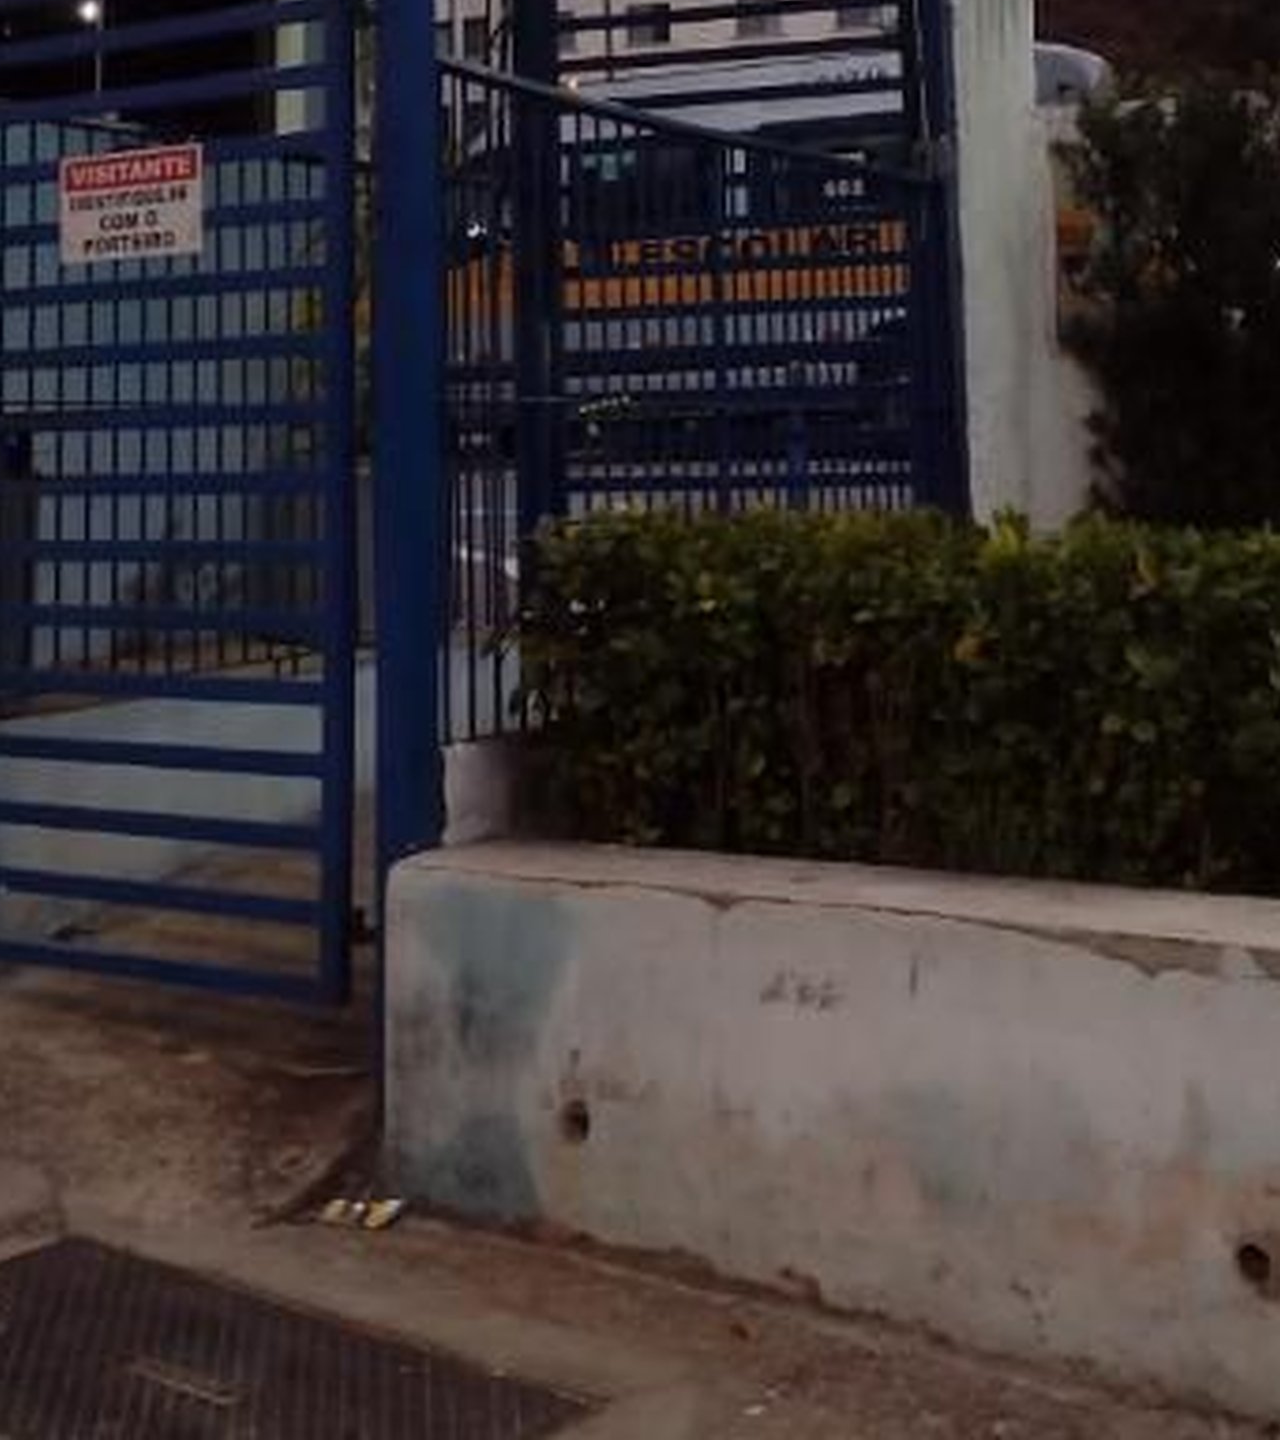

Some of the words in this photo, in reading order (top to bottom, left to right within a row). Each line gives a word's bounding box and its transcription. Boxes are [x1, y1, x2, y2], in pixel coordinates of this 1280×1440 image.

[69, 157, 192, 187] VISITANTE
[99, 212, 139, 231] COM
[143, 208, 158, 227] O
[83, 230, 176, 257] PORTEIRO
